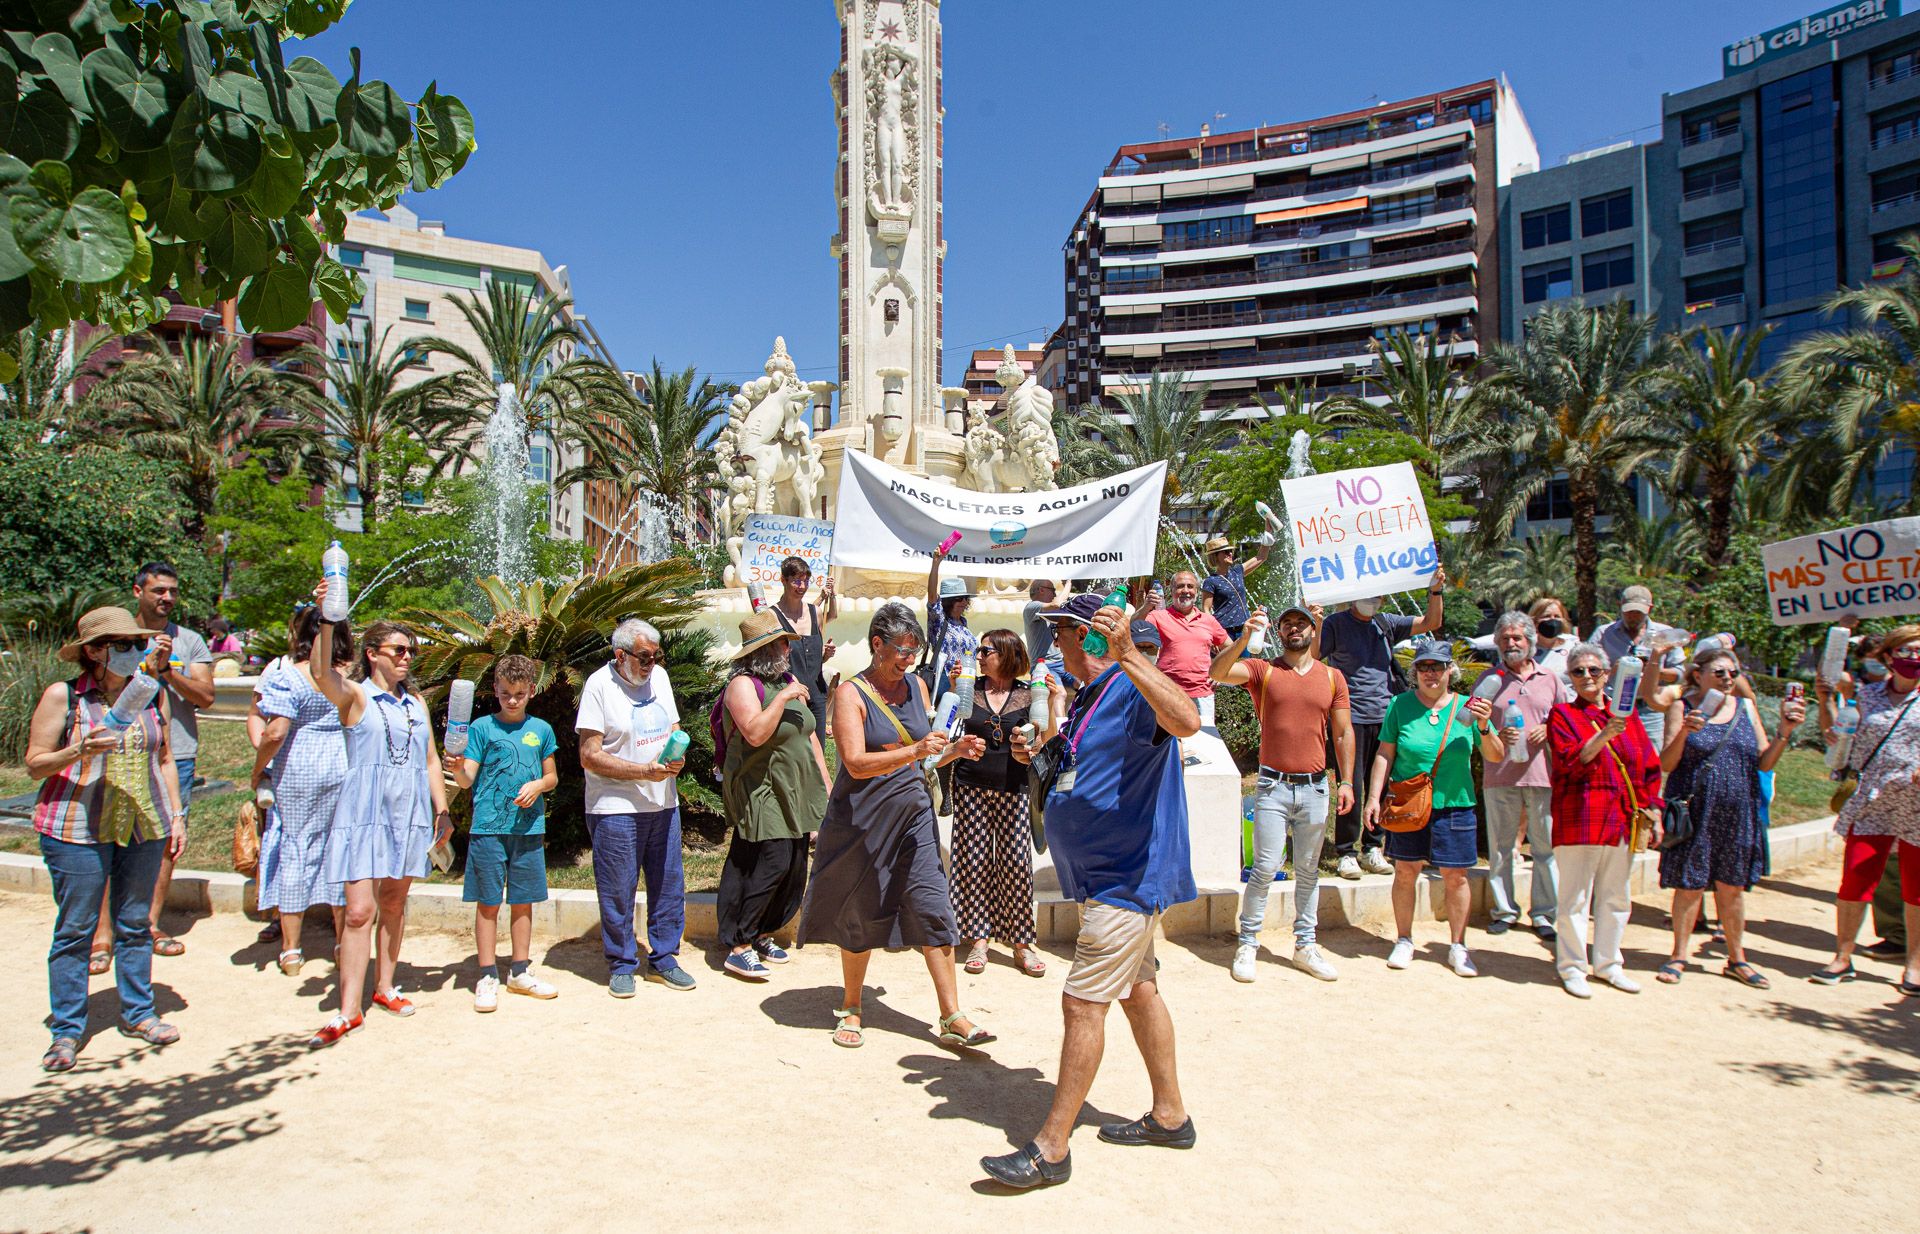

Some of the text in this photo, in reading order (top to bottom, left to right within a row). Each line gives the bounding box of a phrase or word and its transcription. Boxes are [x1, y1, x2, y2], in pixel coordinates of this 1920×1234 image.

[1769, 0, 1885, 49] cajamar
[889, 479, 1131, 515] MASCLETAES AQUI NO
[1336, 475, 1382, 508] NO
[1297, 507, 1346, 548] MÁS
[902, 548, 1123, 566] SALVM EL NOSTRE PATRIMONI
[1817, 529, 1885, 566] NO
[1301, 553, 1345, 584] EN
[1768, 556, 1825, 593] MÁS
[1777, 582, 1920, 617] EN LUCERO
[636, 738, 650, 747] SOS
